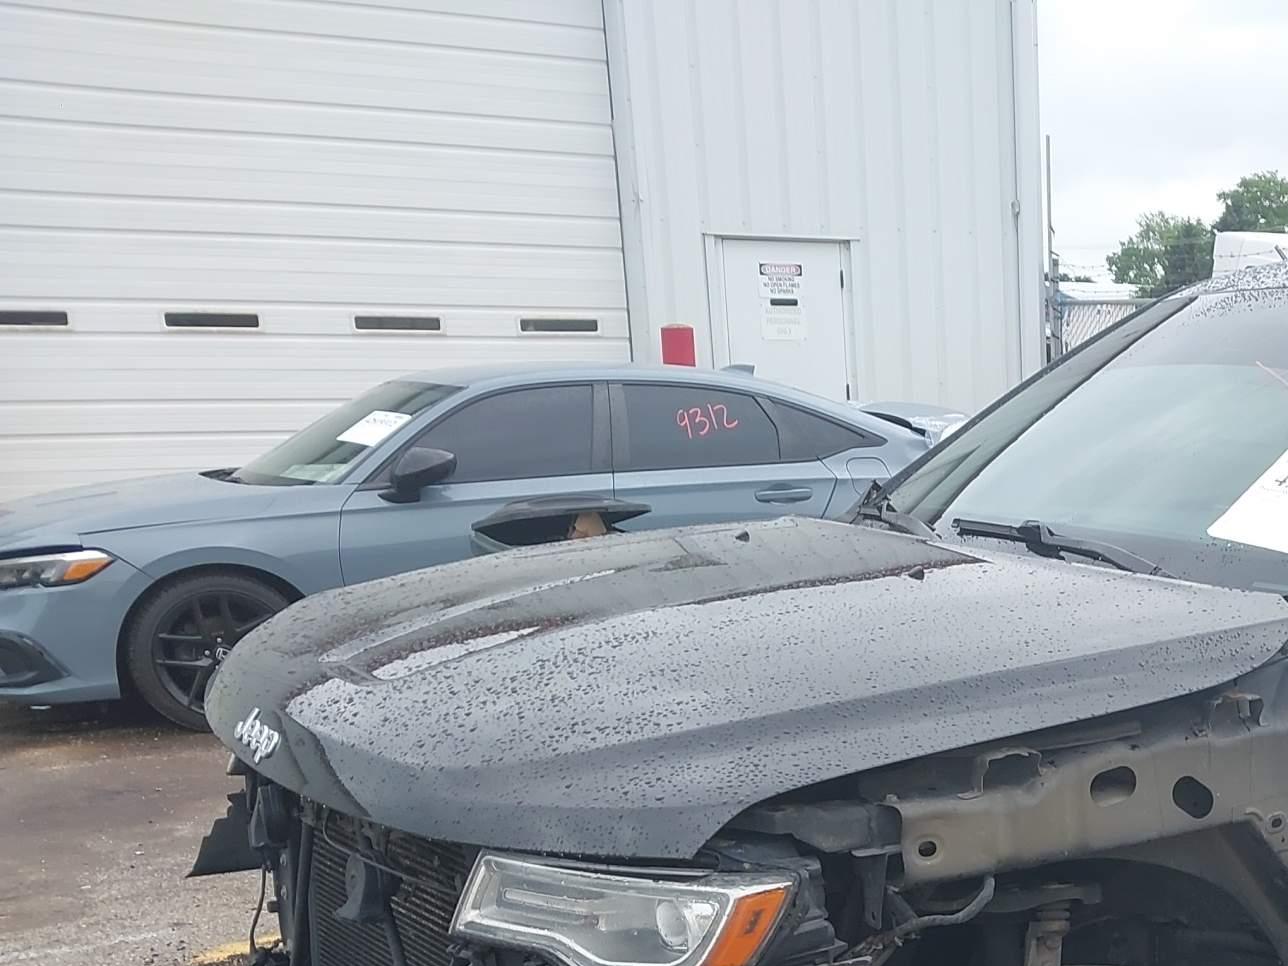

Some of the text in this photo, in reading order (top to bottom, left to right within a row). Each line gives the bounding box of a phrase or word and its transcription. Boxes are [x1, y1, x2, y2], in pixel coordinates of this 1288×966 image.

[764, 265, 798, 274] DANGER
[676, 403, 738, 439] 9312
[234, 707, 280, 764] Jeep
